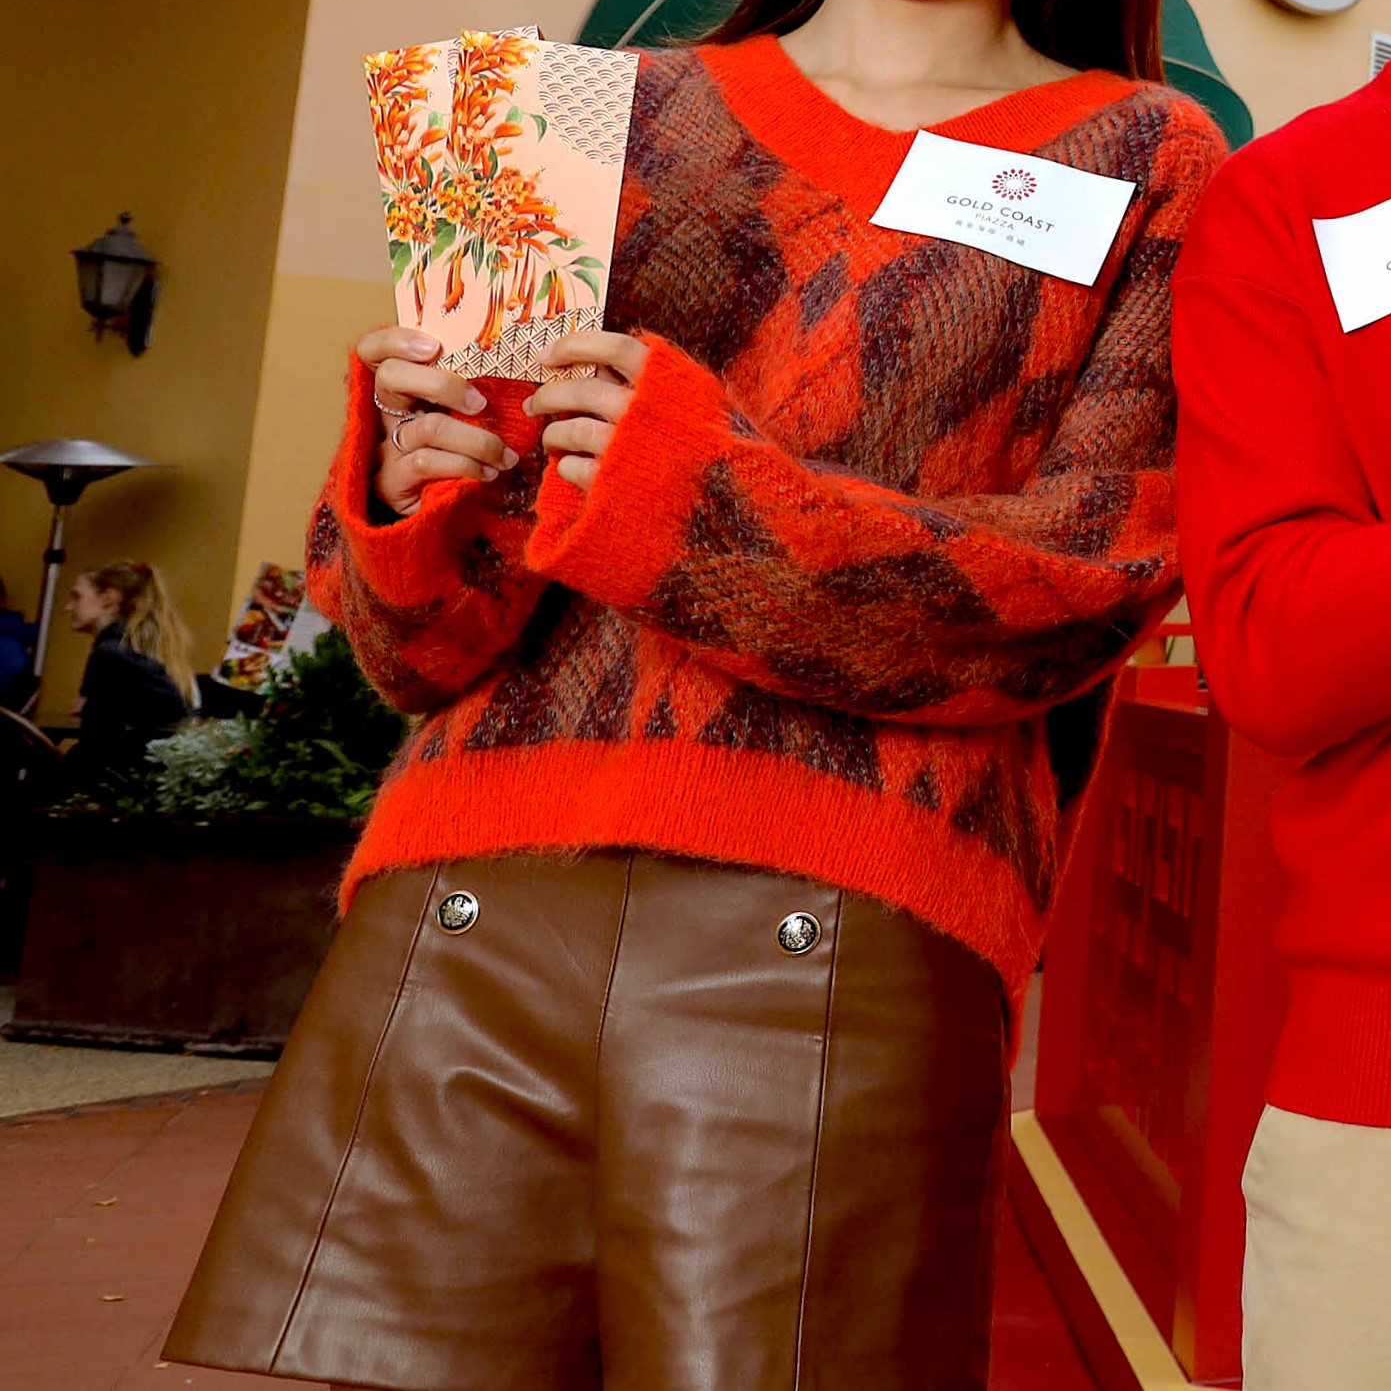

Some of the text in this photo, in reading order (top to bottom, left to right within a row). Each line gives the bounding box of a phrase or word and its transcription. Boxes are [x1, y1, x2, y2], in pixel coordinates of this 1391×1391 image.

[946, 195, 1055, 232] GOLD COAST
[975, 213, 1015, 230] PIAZZA
